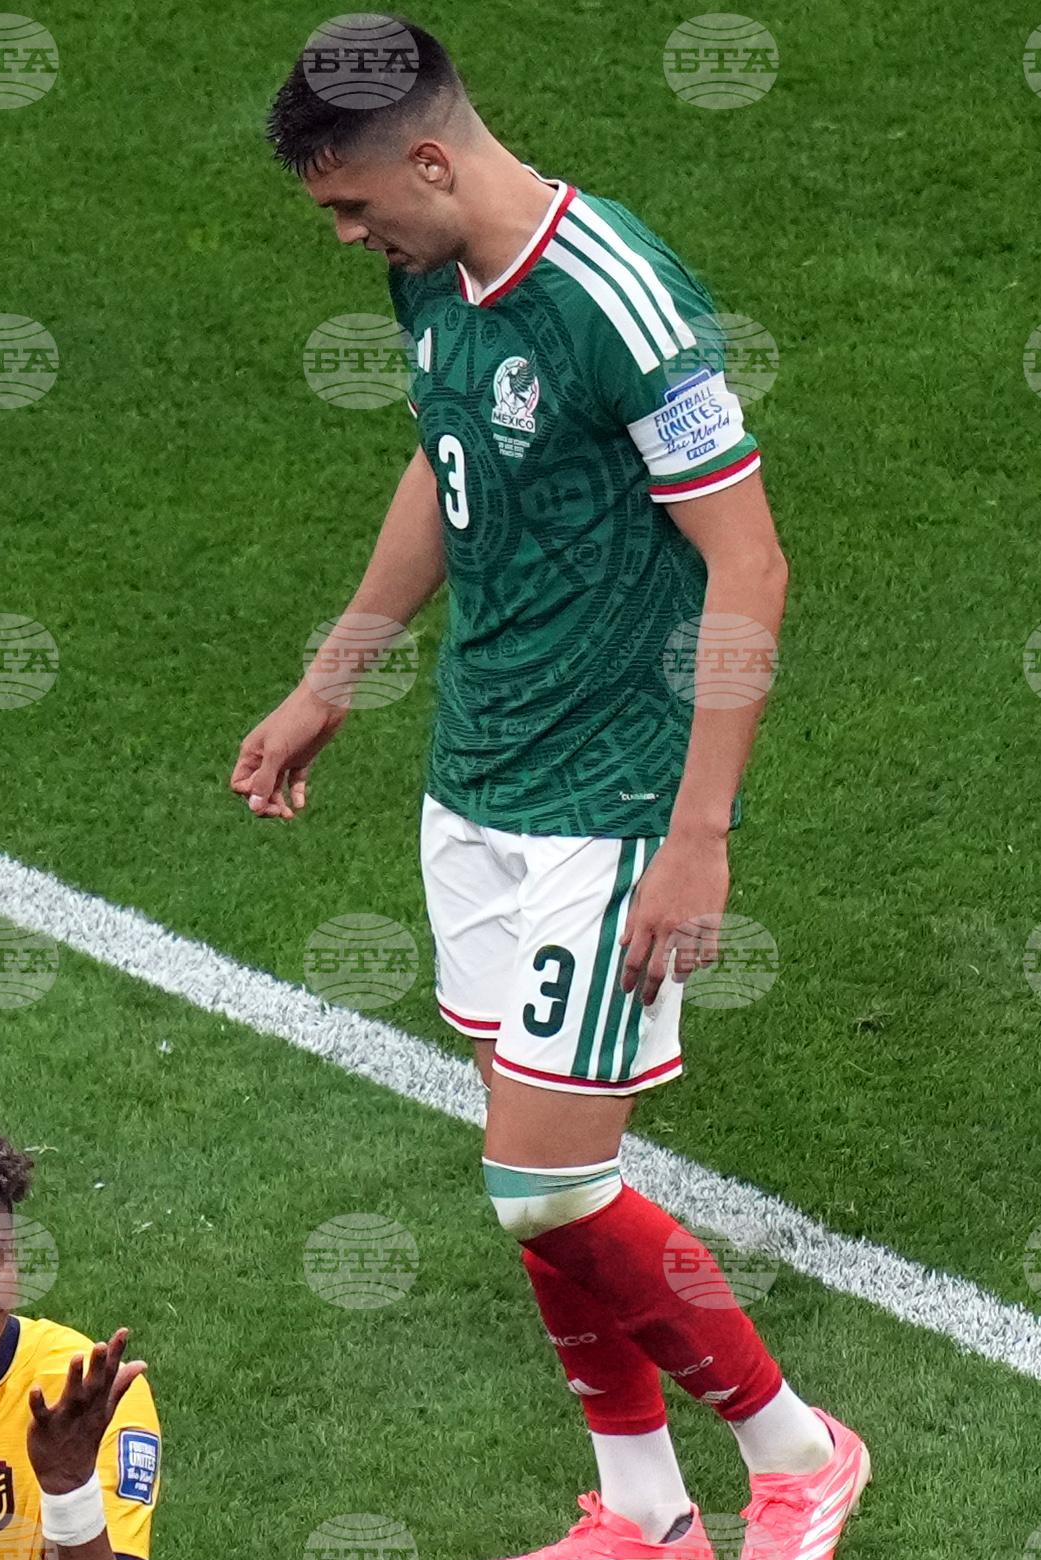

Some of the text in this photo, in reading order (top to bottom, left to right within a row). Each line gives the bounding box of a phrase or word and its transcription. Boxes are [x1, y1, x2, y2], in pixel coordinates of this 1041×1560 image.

[654, 386, 714, 427] FOOTBALL
[658, 398, 722, 442] UNITES
[438, 434, 470, 530] 3
[522, 944, 576, 1038] 3
